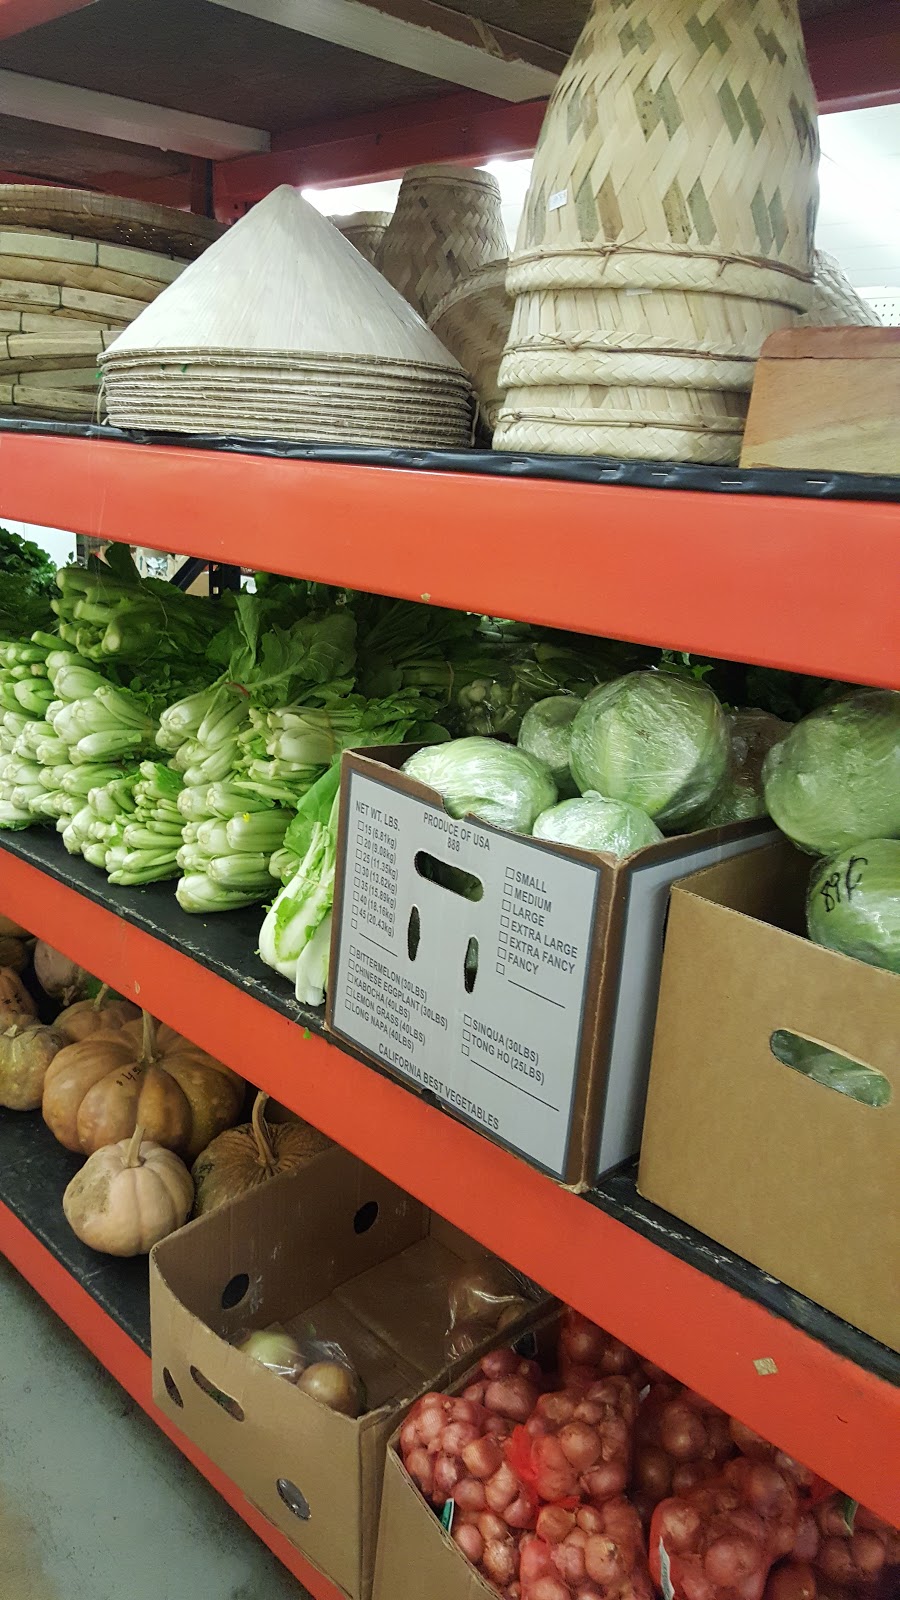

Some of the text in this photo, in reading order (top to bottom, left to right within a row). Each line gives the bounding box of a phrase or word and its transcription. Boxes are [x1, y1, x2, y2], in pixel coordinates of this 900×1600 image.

[356, 800, 400, 831] NET WT. LBS.
[364, 837, 372, 850] 20
[365, 824, 397, 850] 15 (6.81kg)
[423, 812, 490, 850] PRODUCE OF USA
[447, 837, 460, 852] 888
[362, 865, 369, 878] 30
[363, 851, 398, 881] 25 (11.35kg)
[361, 880, 368, 892] 35
[515, 871, 547, 893] SMALL
[359, 907, 366, 920] 45
[360, 894, 368, 906] 40
[514, 887, 552, 912] MEDIUM
[512, 904, 545, 928] LARGE
[511, 920, 578, 959] EXTRA LARGE
[508, 952, 539, 975] FANCY
[510, 936, 576, 974] EXTRA FANCY
[356, 950, 428, 1004] BITTERMELON (30LBS)
[354, 976, 410, 1022] KABOCHA (40LBS)
[355, 963, 448, 1031] CHINESE EGGPLANT (30LBS)
[352, 1004, 414, 1054] LONG NAPA (40LBS)
[353, 990, 426, 1046] LEMON GRASS (40LBS)
[472, 1020, 540, 1066] SINQUA (30LBS)
[472, 1034, 545, 1086] TONG HO (25LBS)
[378, 1043, 500, 1130] CALIFORNIA BEST VEGETABLES
